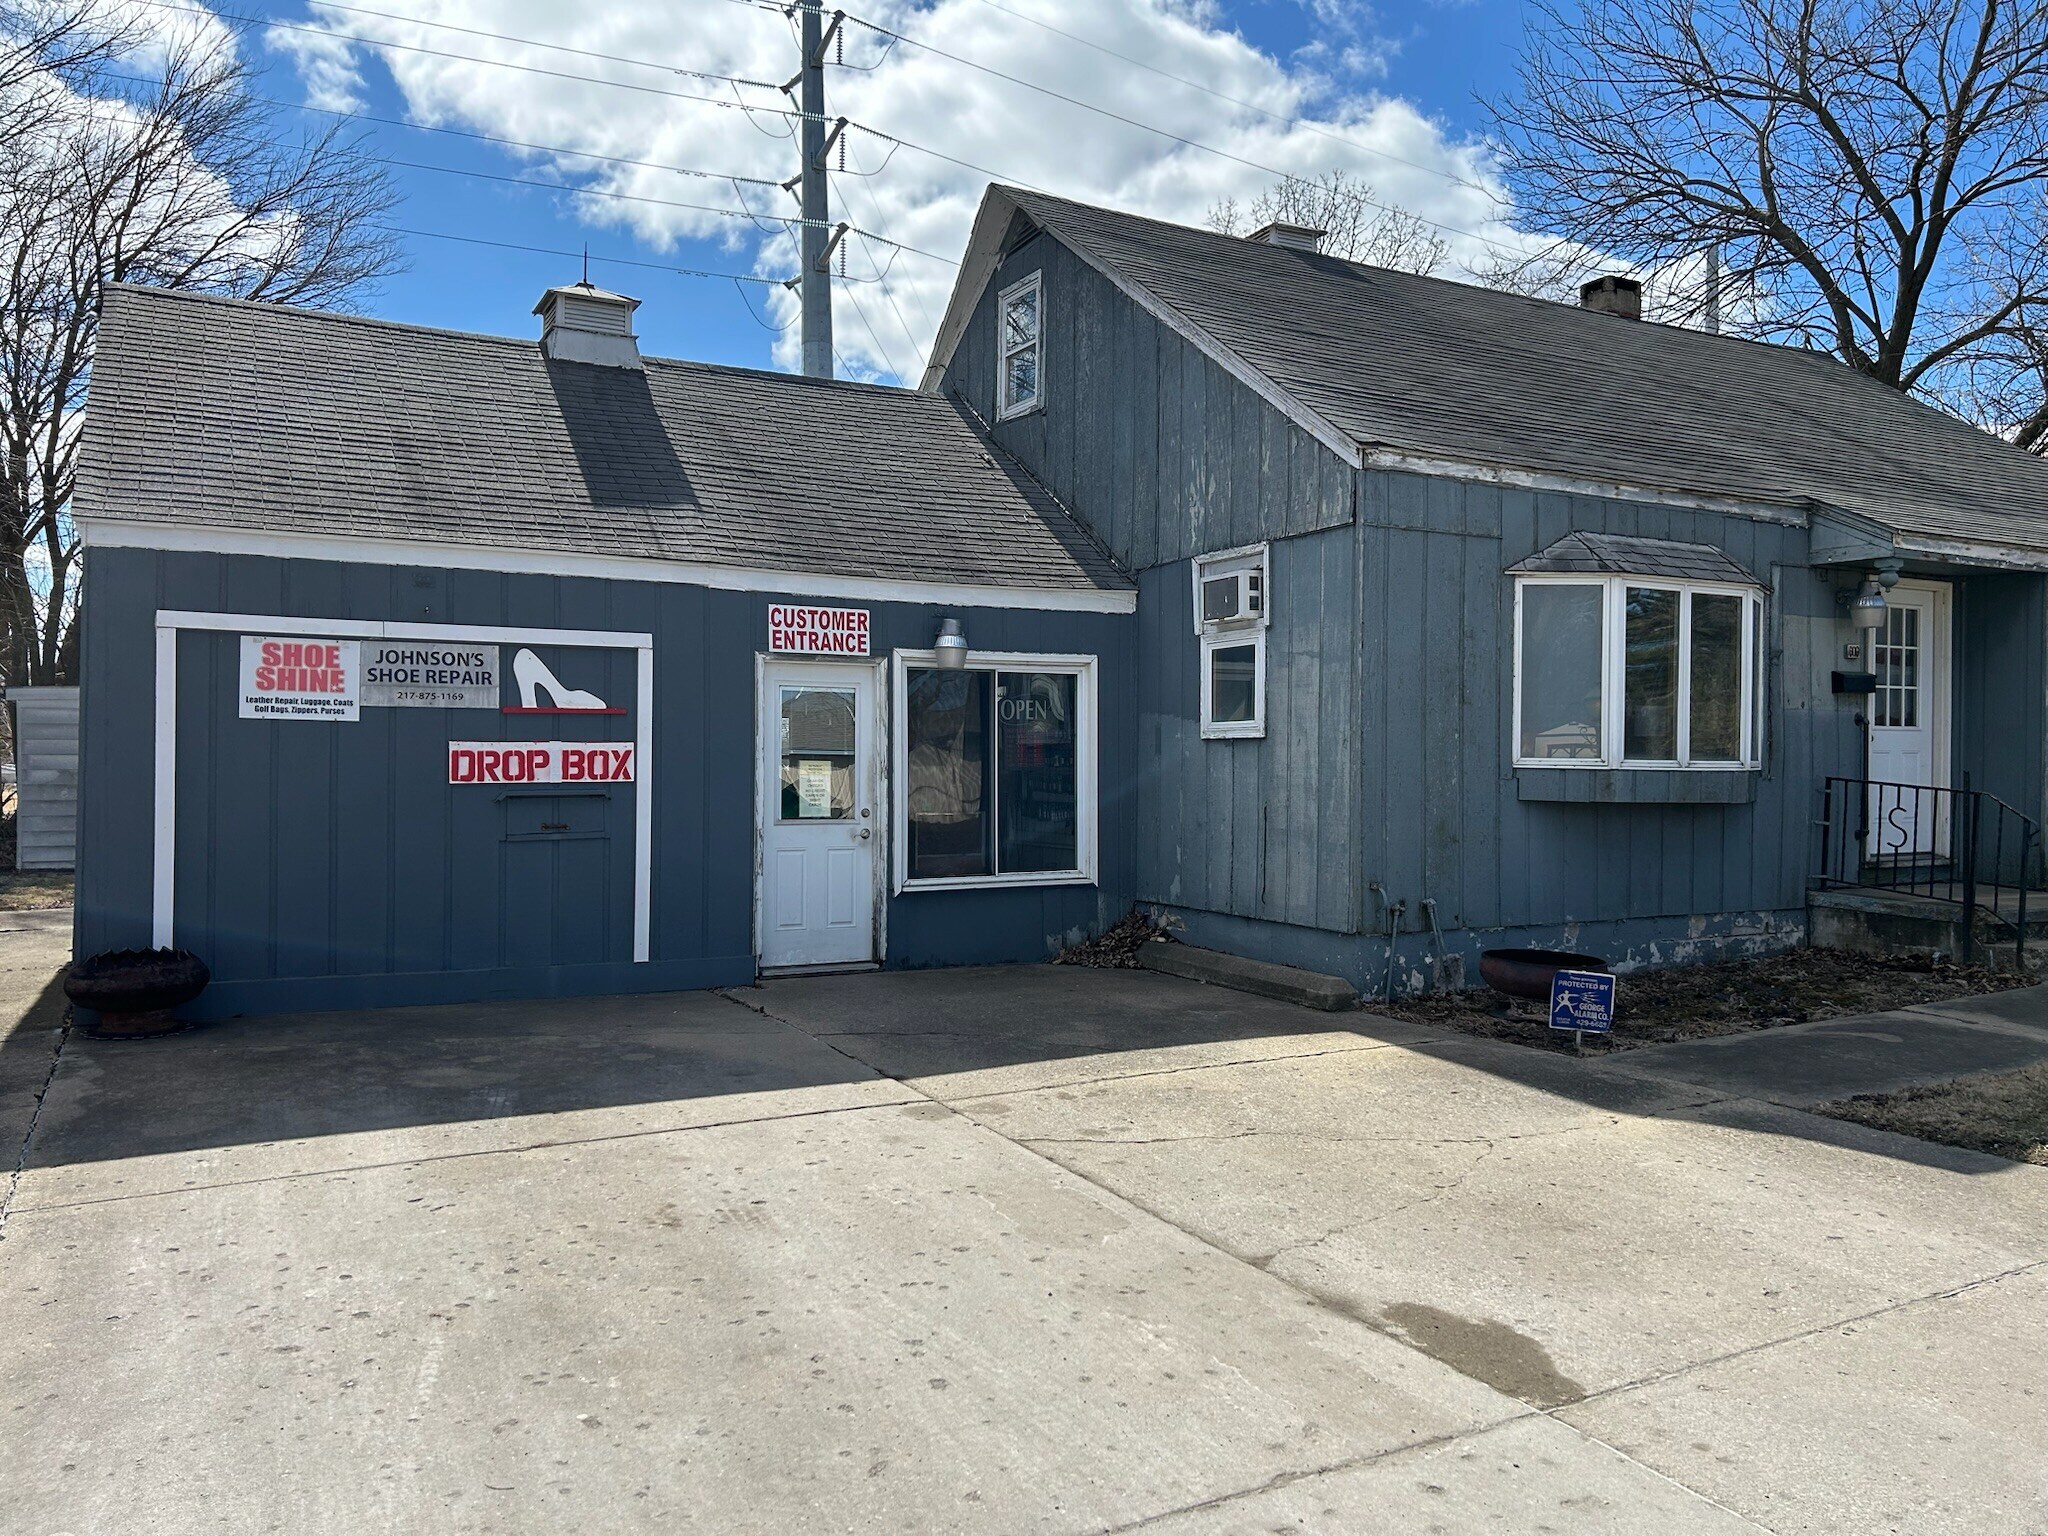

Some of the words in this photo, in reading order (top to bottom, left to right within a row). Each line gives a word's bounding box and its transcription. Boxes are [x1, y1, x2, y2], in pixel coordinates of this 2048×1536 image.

[771, 607, 868, 632] CUSTOMER
[772, 630, 868, 653] ENTRANCE
[261, 642, 340, 669] SHOE
[375, 649, 484, 667] JOHNSON'S
[256, 666, 345, 693] SHINE
[367, 667, 420, 683] SHOE
[425, 669, 493, 685] REPAIR
[245, 696, 273, 704] Leather
[333, 699, 354, 707] Coats
[397, 691, 464, 701] 217-875-1169
[254, 705, 269, 713] Golf
[320, 707, 345, 715] Purses
[1000, 699, 1047, 720] OPEN
[451, 750, 550, 782] DROP
[561, 750, 633, 780] BOX
[1558, 980, 1598, 990] PROTECTED
[1574, 1010, 1597, 1019] ALARM
[1579, 1003, 1605, 1013] GEORGE
